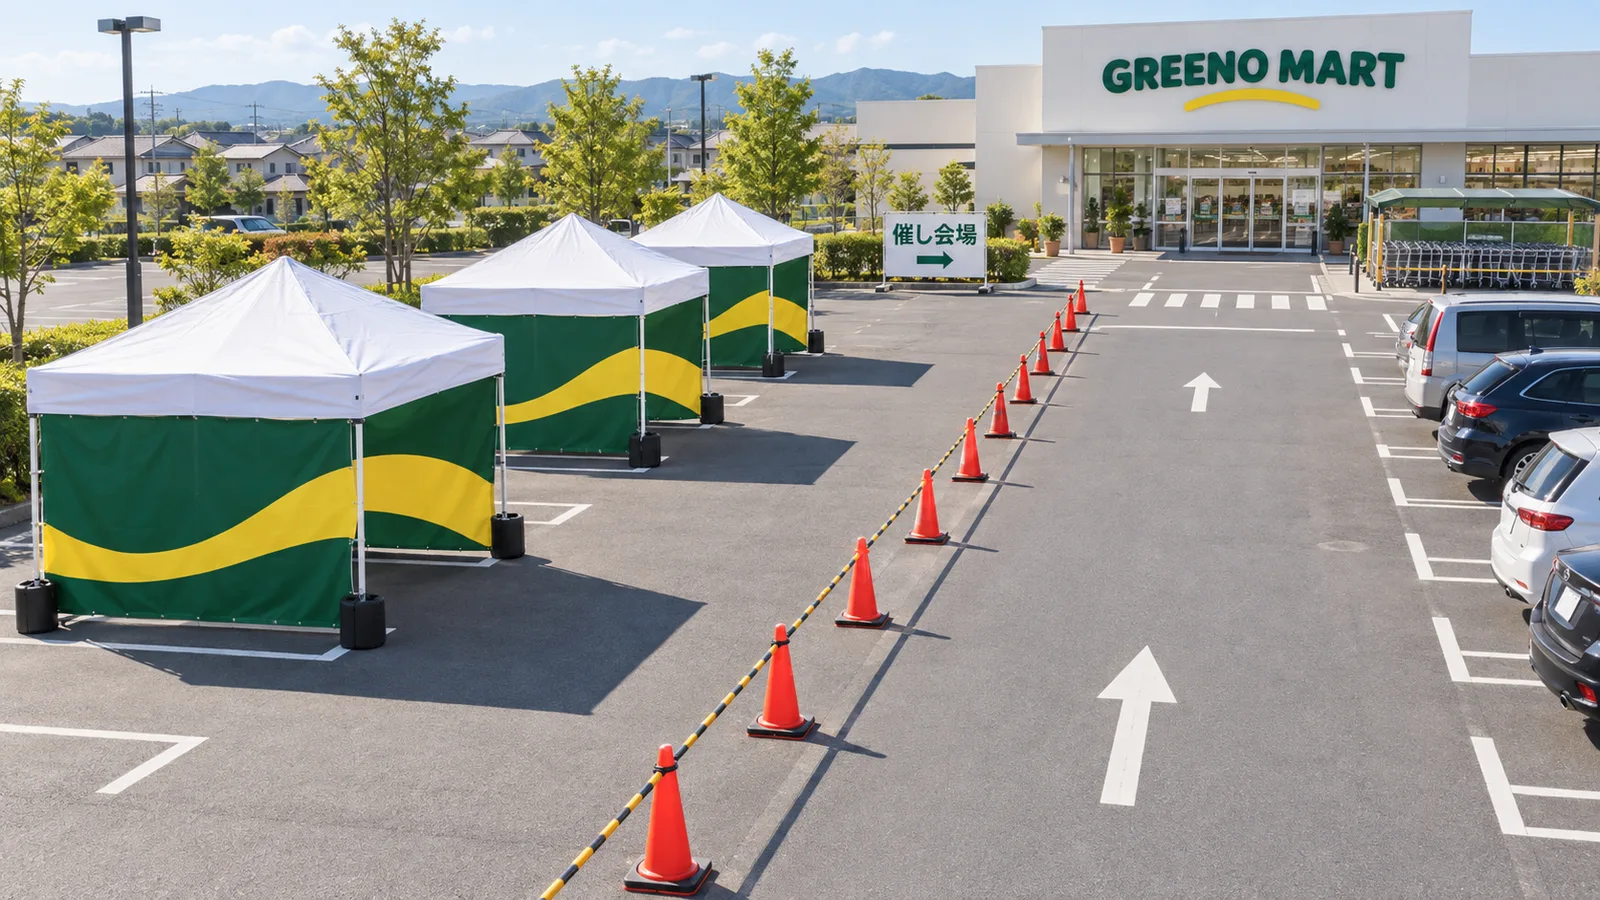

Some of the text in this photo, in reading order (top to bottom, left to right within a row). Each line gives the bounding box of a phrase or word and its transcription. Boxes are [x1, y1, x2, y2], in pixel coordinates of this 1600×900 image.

[1103, 48, 1406, 94] GREENO MART
[892, 223, 977, 246] 催し会場
